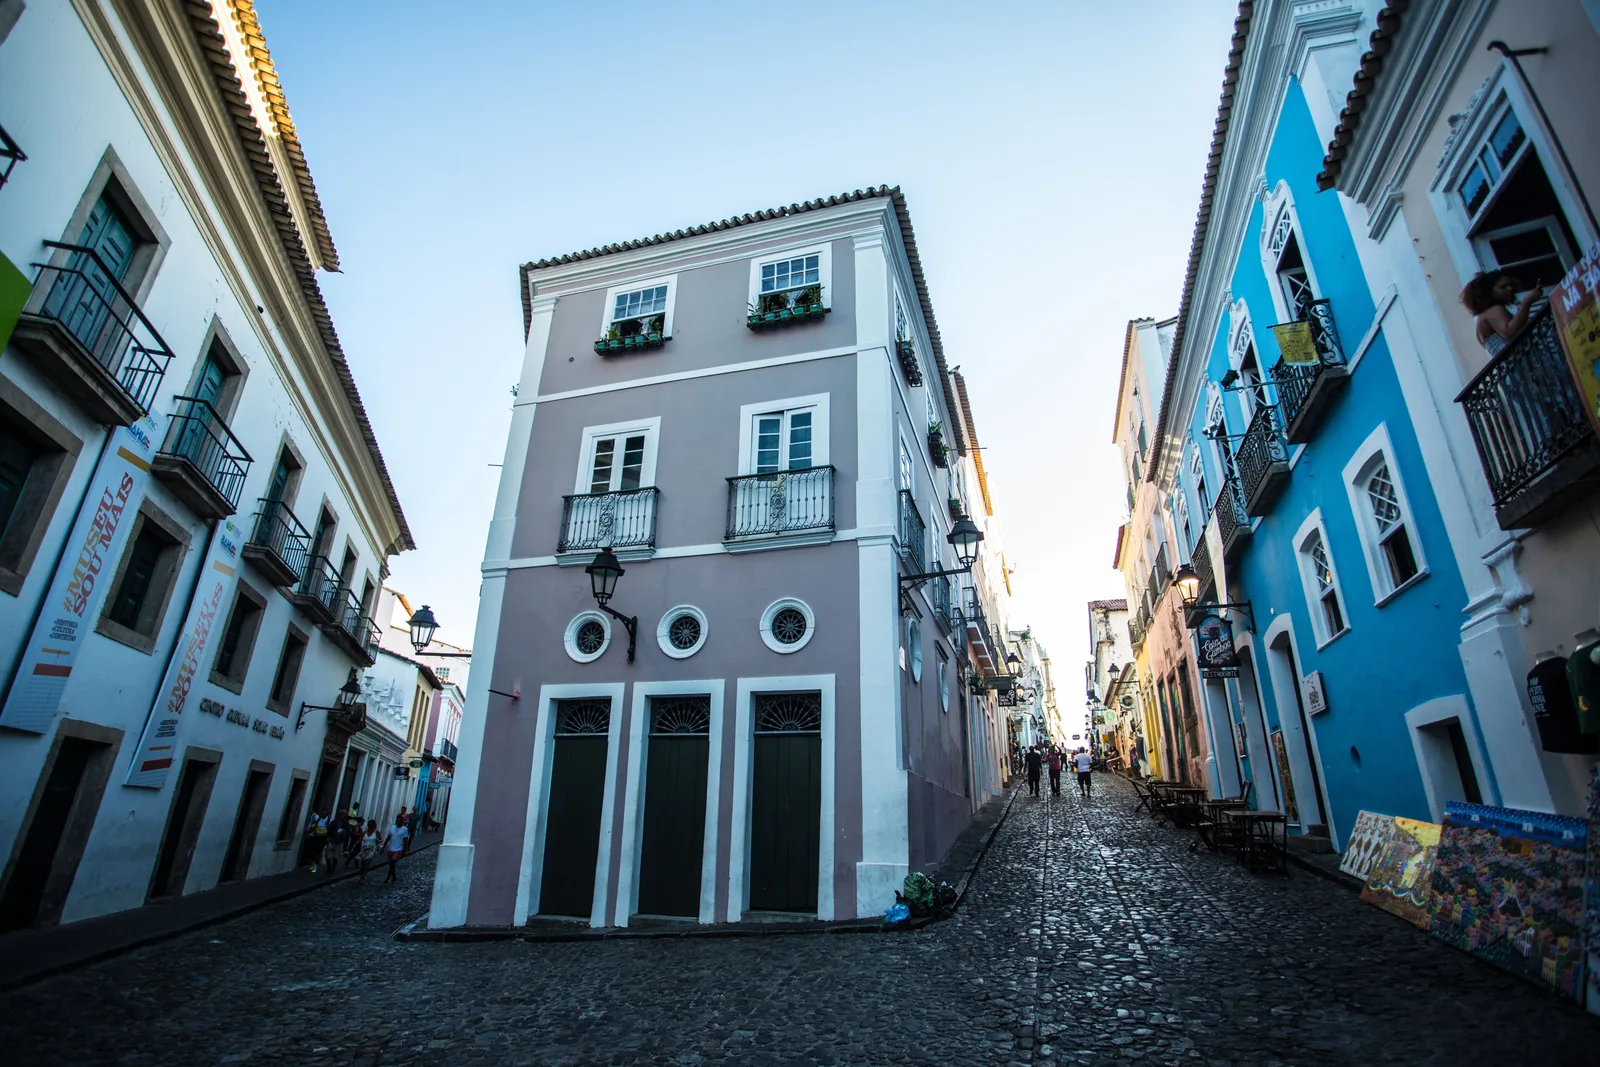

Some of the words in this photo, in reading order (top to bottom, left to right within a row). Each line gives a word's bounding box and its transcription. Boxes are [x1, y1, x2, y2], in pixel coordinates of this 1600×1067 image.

[1562, 284, 1581, 312] NA
[74, 550, 102, 618] SOU
[98, 472, 134, 552] MAIS
[175, 657, 198, 715] SOU
[195, 582, 223, 654] MAIS
[1201, 639, 1220, 652] Casa
[1220, 632, 1229, 643] da
[1206, 640, 1231, 664] Gamboa
